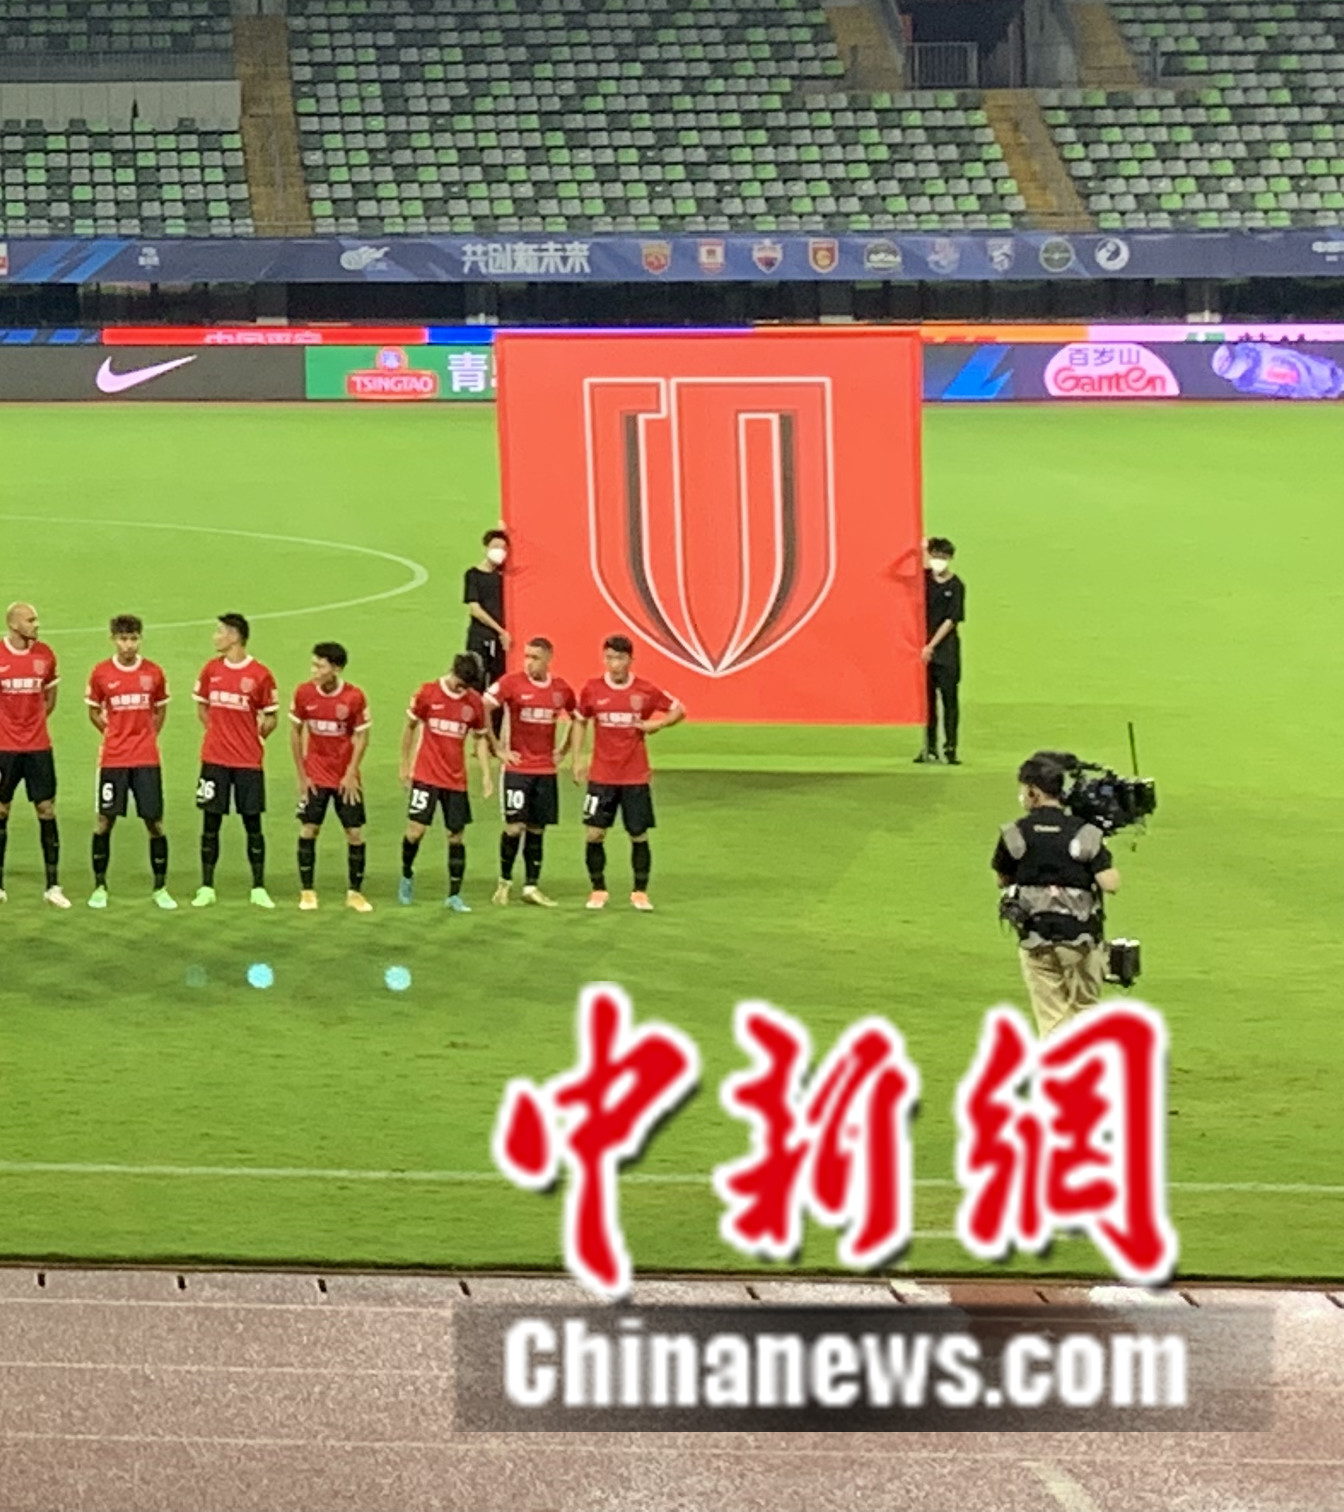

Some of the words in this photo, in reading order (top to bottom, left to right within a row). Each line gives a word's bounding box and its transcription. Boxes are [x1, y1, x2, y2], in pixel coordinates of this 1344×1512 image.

[461, 242, 592, 274] 共创新未来
[1068, 347, 1141, 366] 百岁山
[448, 351, 497, 393] 青
[351, 375, 434, 393] TSINGTAO
[102, 782, 114, 801] 6
[411, 789, 430, 810] 15
[506, 789, 524, 809] 10
